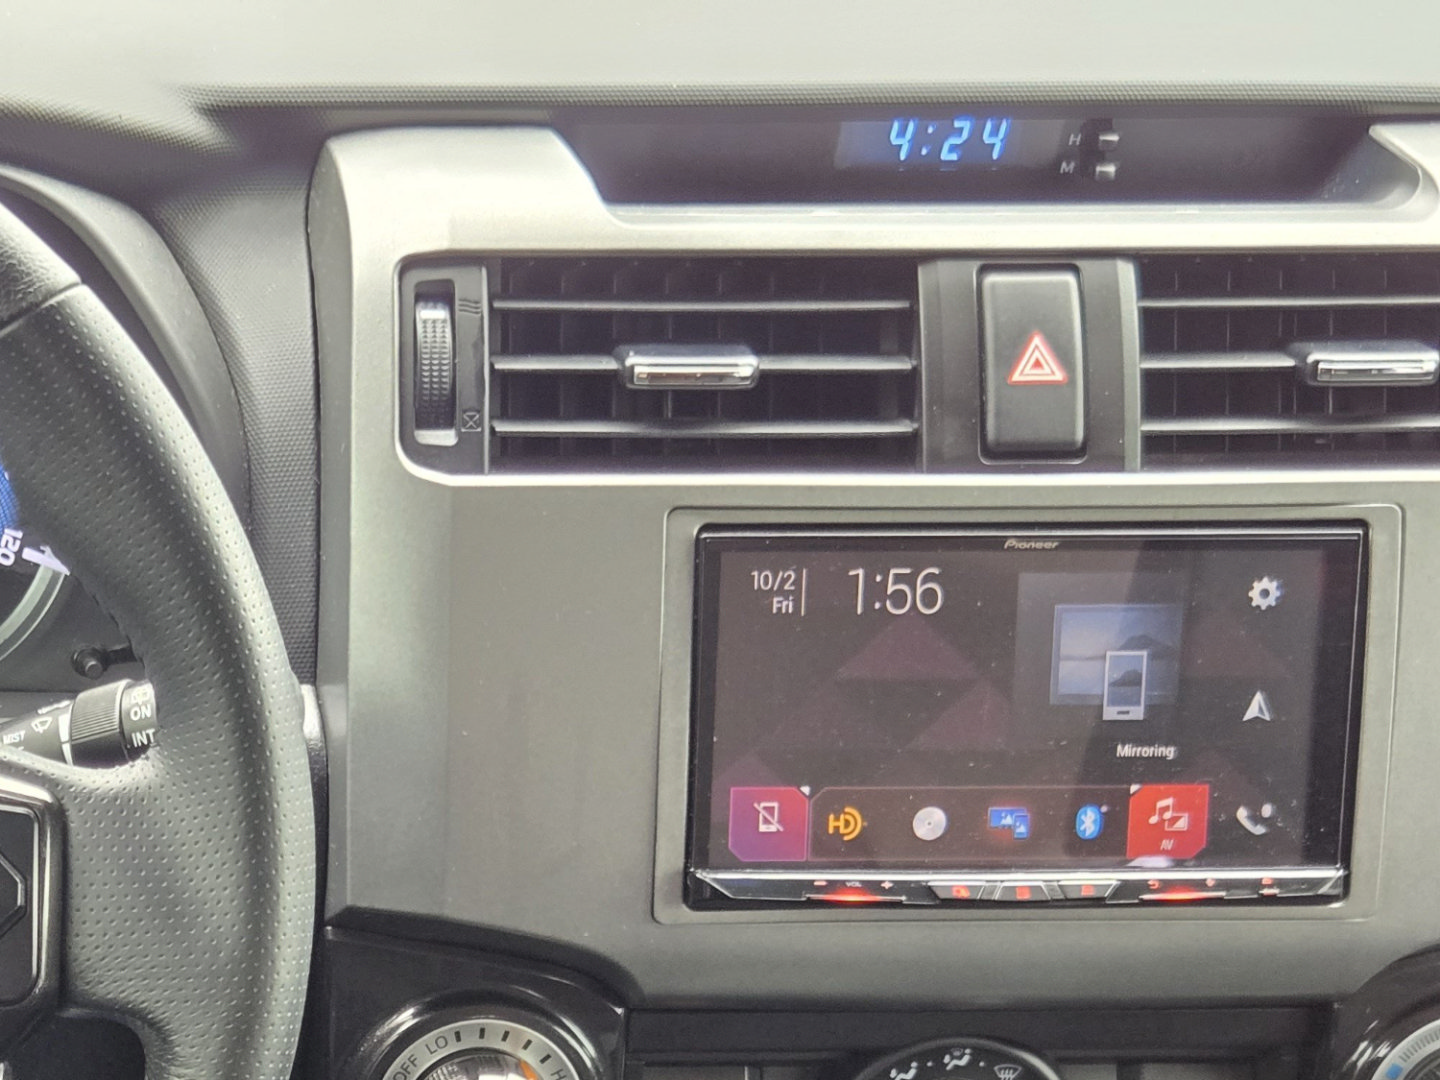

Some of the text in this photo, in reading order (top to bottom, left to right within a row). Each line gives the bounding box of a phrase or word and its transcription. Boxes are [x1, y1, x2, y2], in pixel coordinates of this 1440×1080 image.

[889, 117, 1010, 161] 4:24
[1068, 134, 1082, 147] H
[1060, 161, 1075, 174] M
[1004, 538, 1059, 550] Pioneer
[750, 567, 796, 592] 10/2
[847, 566, 945, 616] 1:56
[772, 596, 794, 615] Fri
[129, 703, 152, 722] ON
[131, 728, 156, 748] INT
[1116, 743, 1176, 760] Mirroring
[1160, 839, 1175, 851] AV
[425, 1034, 449, 1056] LO
